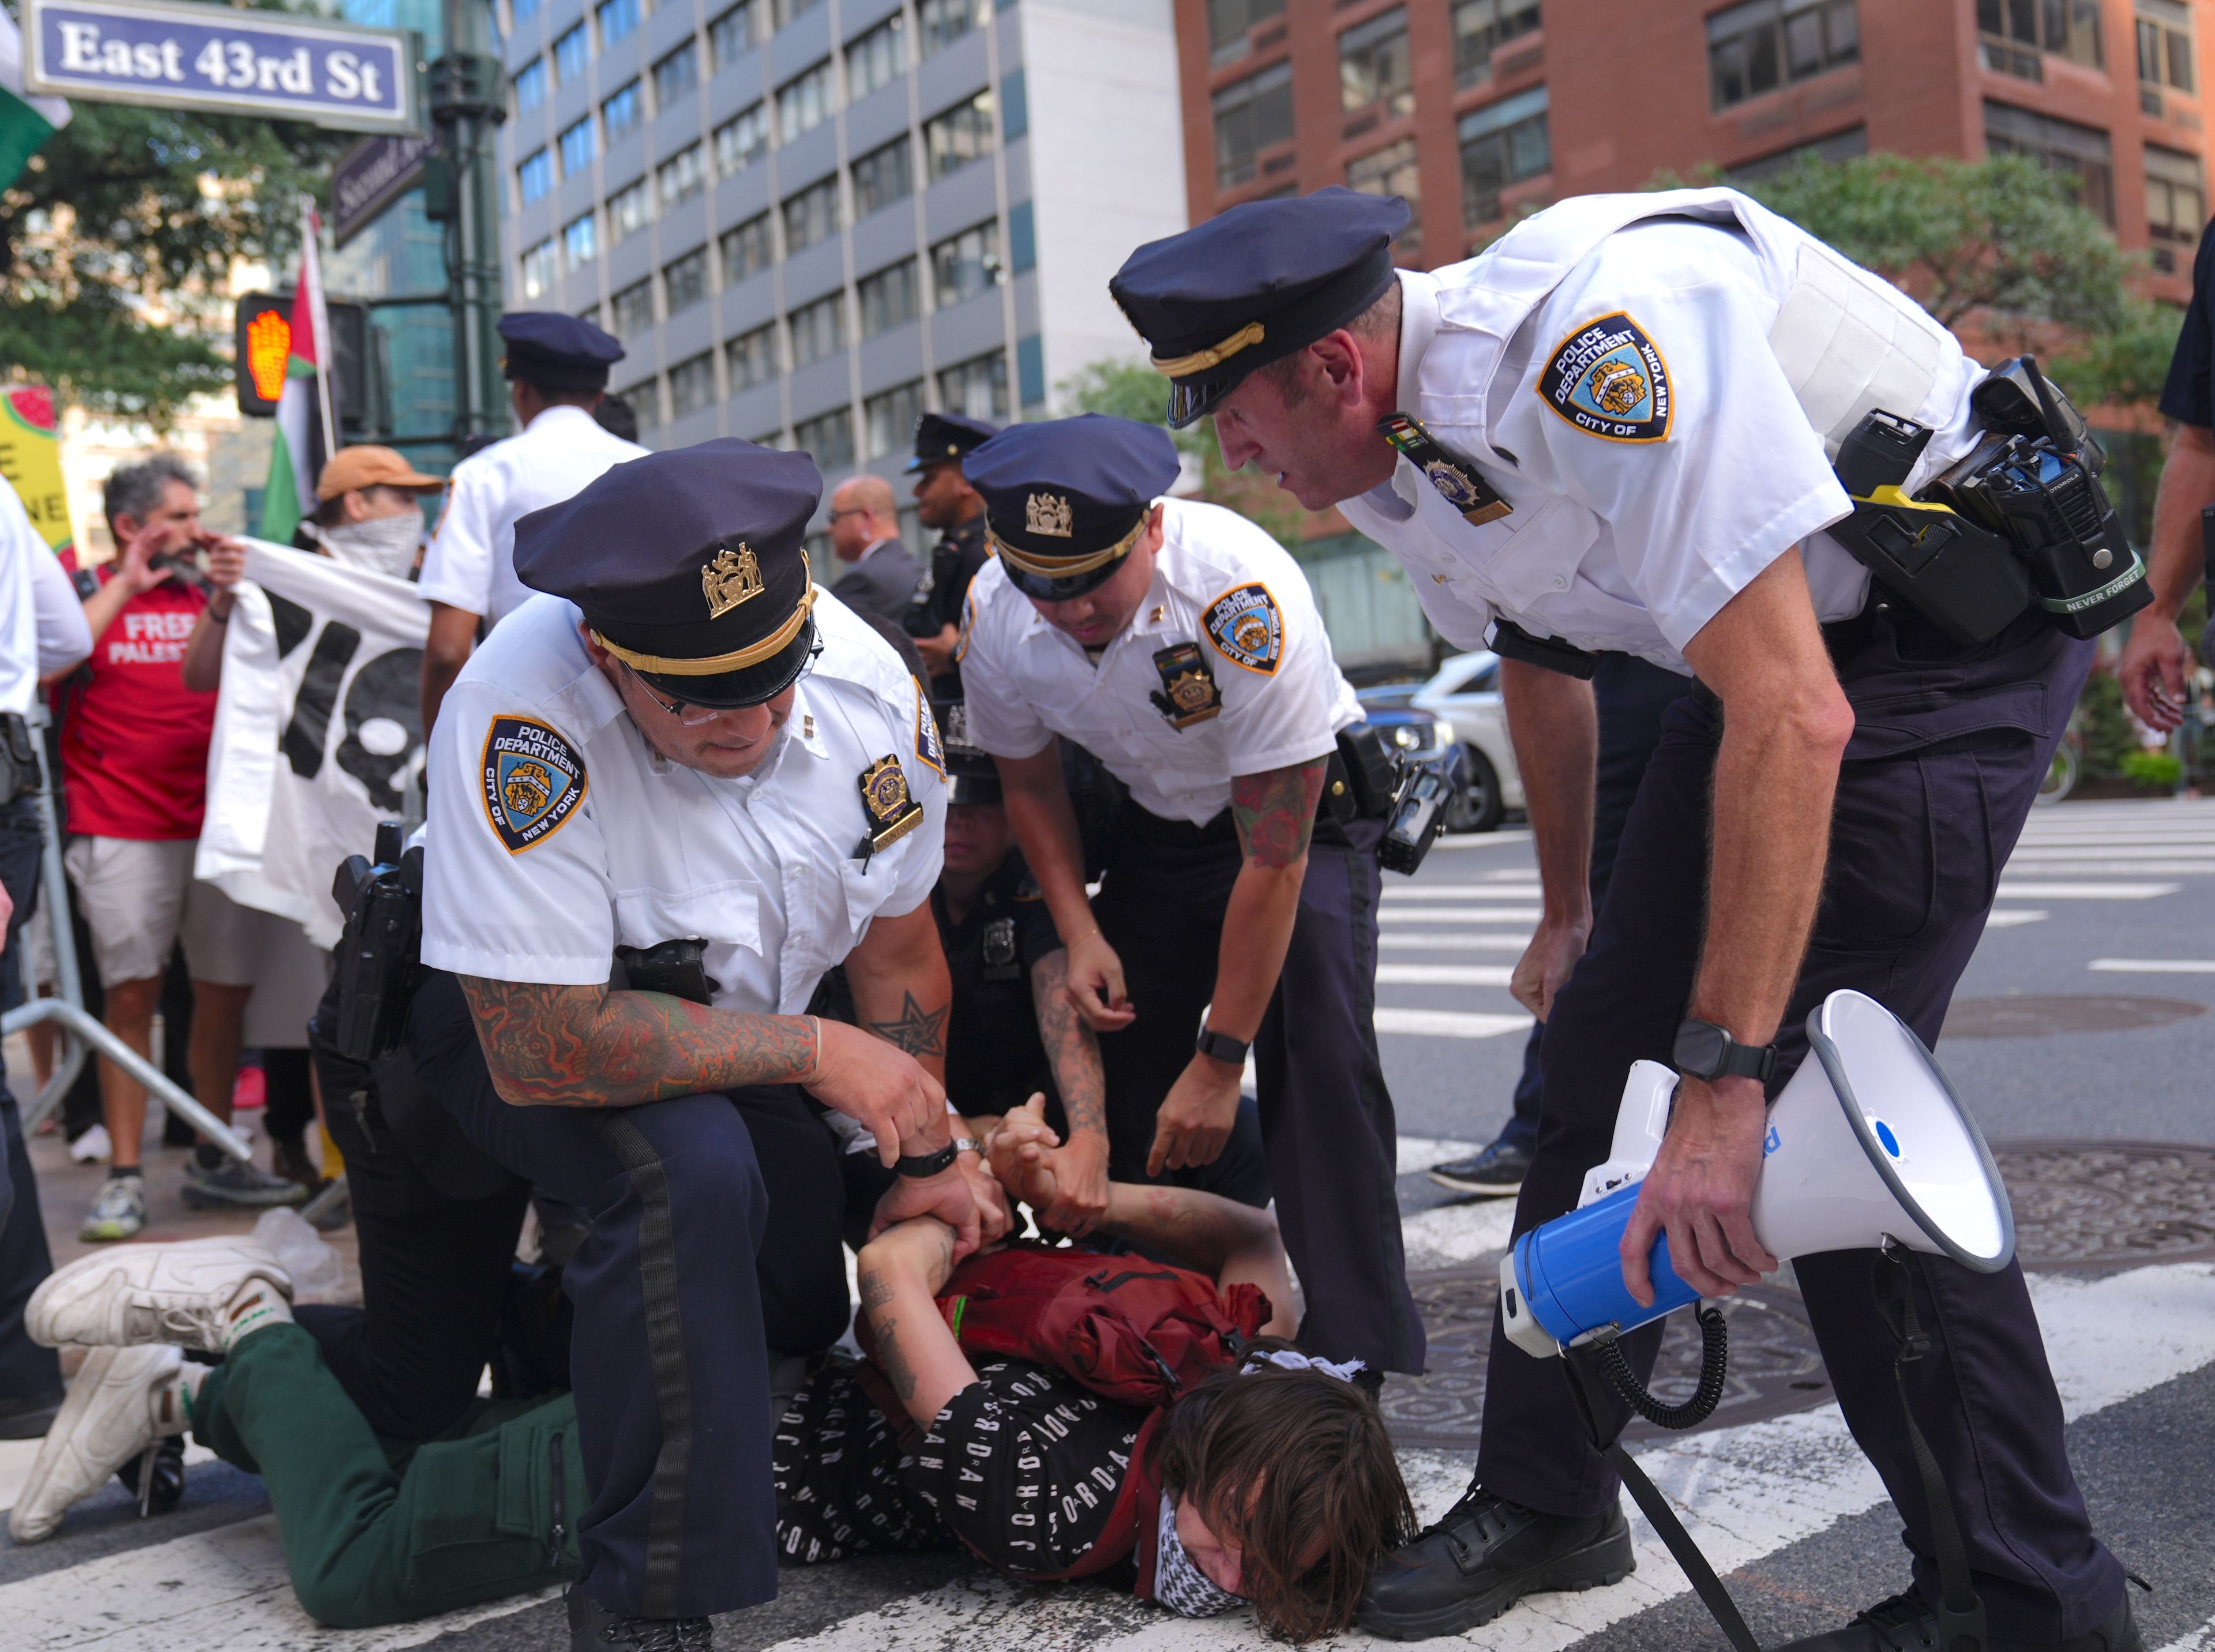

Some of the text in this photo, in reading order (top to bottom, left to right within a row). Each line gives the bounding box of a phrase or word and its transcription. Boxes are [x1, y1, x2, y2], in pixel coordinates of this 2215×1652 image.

[57, 20, 383, 102] East 43rd St
[1555, 327, 1606, 375] POLICE
[1555, 329, 1636, 405] DEPARTMENT
[1640, 343, 1667, 418] NEW YORK
[1575, 412, 1637, 436] CITY OF
[2044, 474, 2079, 497] OTOROLA
[1214, 588, 1252, 615] POLICE
[2066, 569, 2139, 611] NEVER FORGET
[1209, 594, 1269, 635] DEPARTMENT
[1268, 606, 1281, 660] NEW YORK
[1220, 641, 1259, 667] CITY OF
[494, 737, 581, 780] DEPARTMENT
[517, 726, 568, 757] POLICE
[486, 767, 506, 826] CITY OF
[521, 787, 580, 842] NEW YORK
[876, 814, 922, 850] KOUNTOURIS
